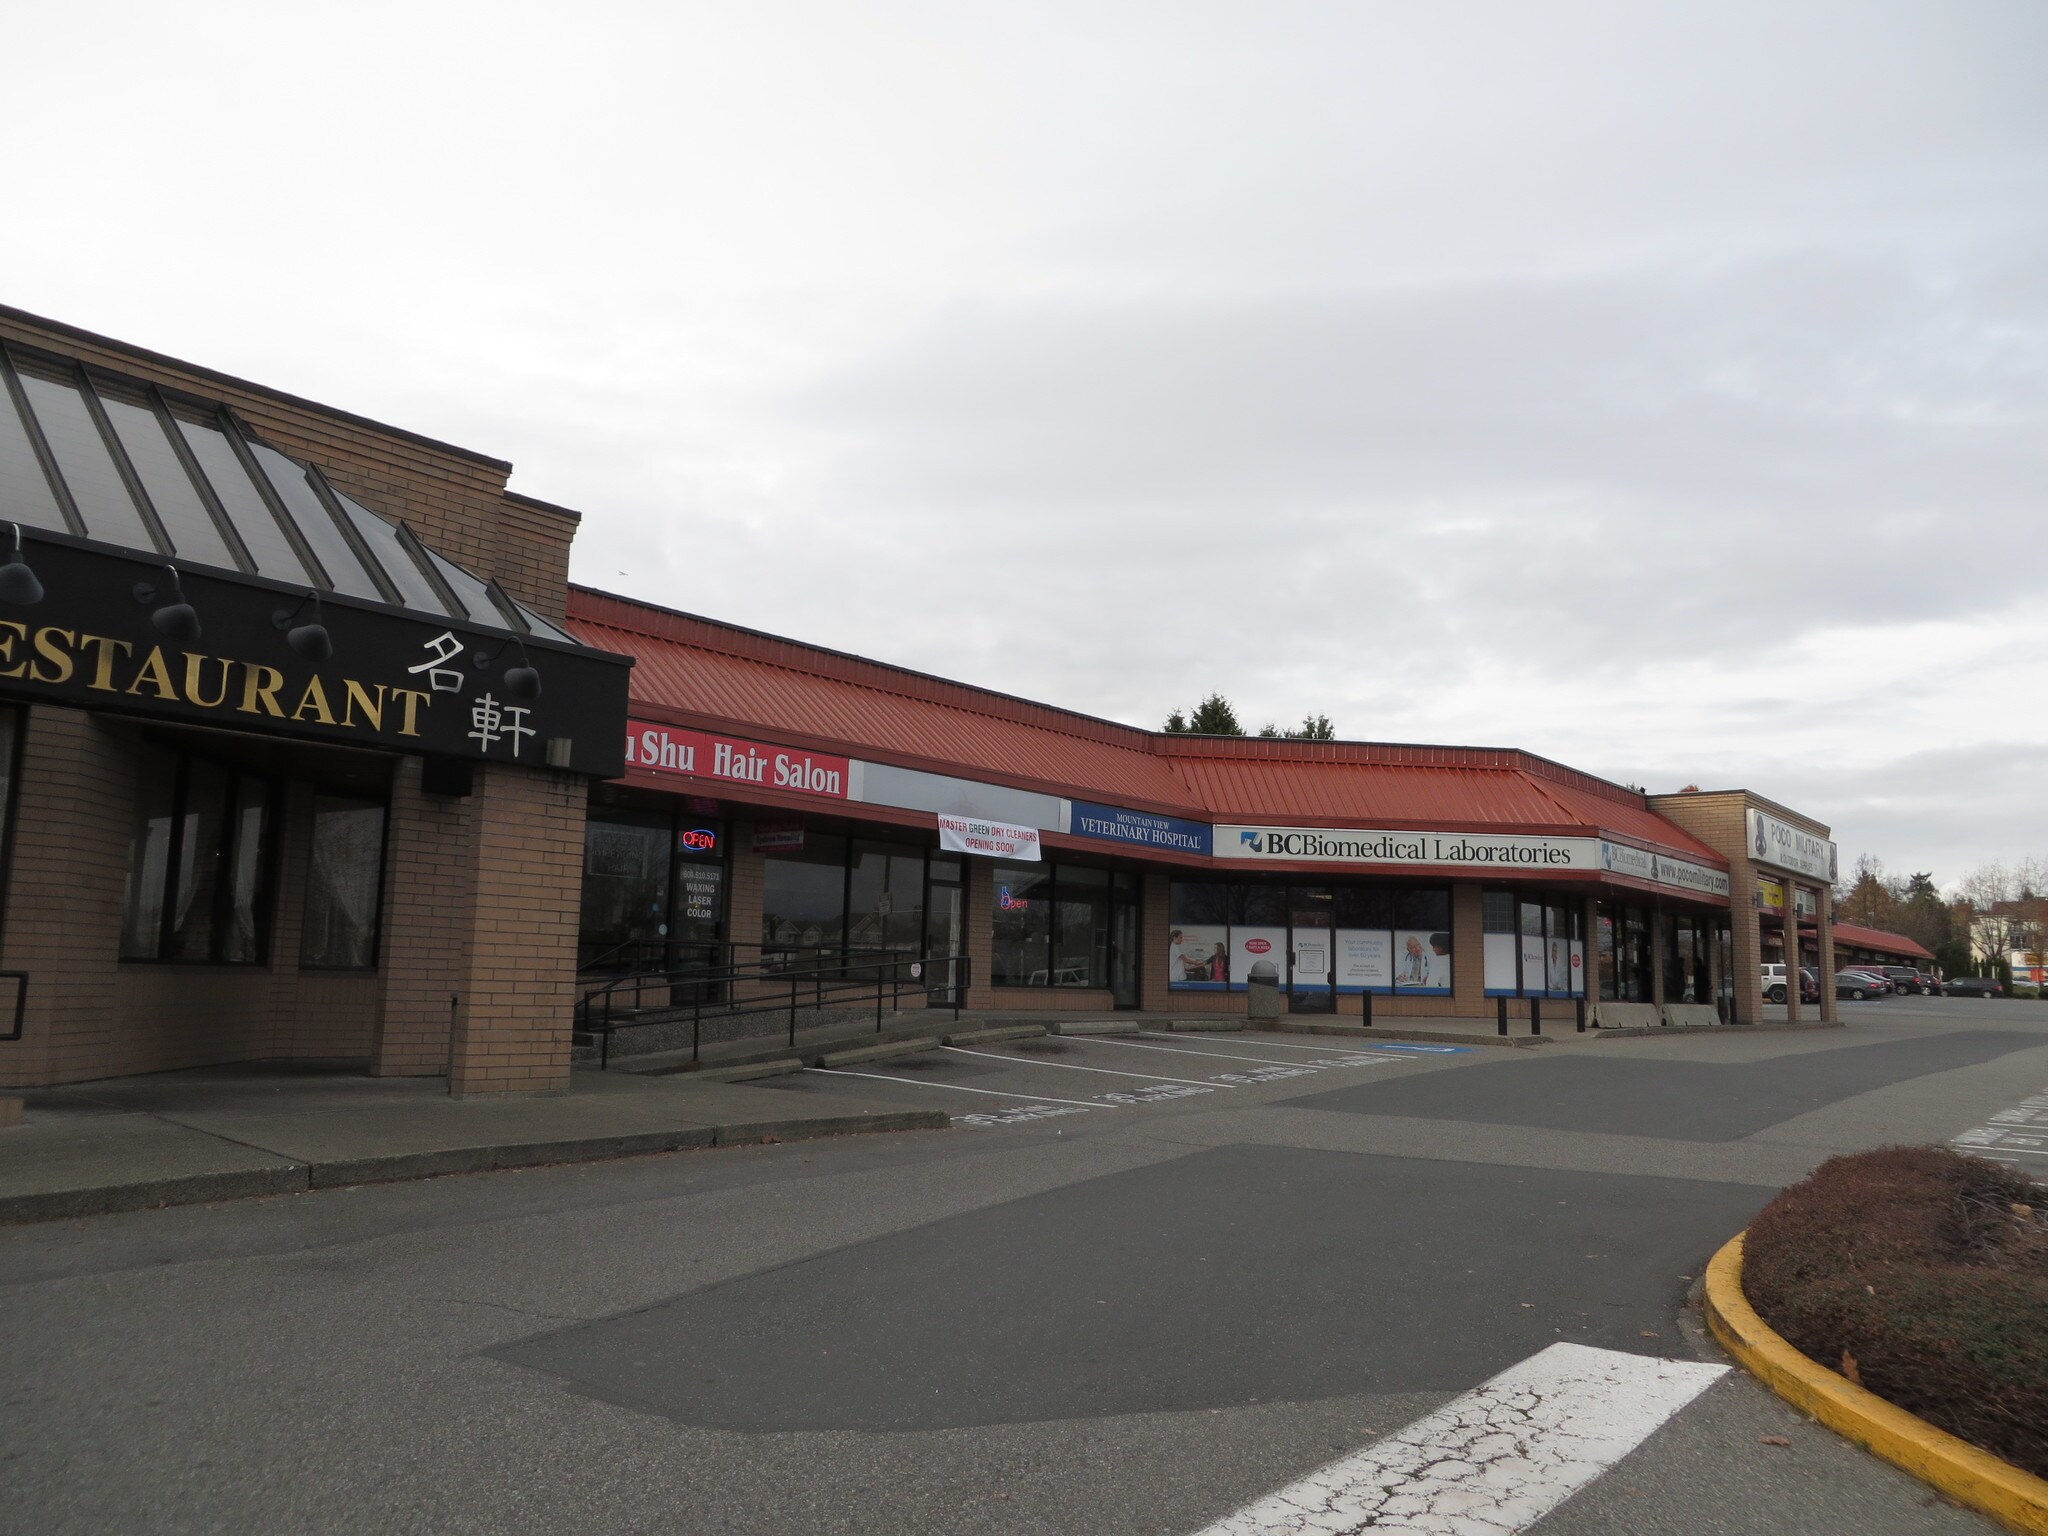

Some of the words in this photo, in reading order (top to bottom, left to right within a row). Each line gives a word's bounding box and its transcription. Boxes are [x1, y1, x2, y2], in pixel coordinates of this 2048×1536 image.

[408, 631, 537, 758] 名軒
[641, 730, 694, 771] Shu
[713, 742, 767, 782] Hair
[774, 754, 840, 794] Salon
[940, 818, 968, 832] MASTER
[969, 823, 990, 835] GREEN
[991, 827, 1005, 837] DRY
[1006, 829, 1037, 842] CLEANERS
[1080, 817, 1150, 841] VETERINARY
[1152, 829, 1201, 849] HOSPITAL
[1116, 813, 1152, 827] MOUNTAIN
[1153, 820, 1170, 830] VIEW
[682, 831, 714, 849] OPEN
[965, 838, 994, 851] OPENING
[995, 841, 1015, 853] SOON
[1266, 832, 1427, 860] BCBiomedical
[1434, 839, 1571, 864] Laboratories
[1771, 823, 1792, 848] POCO
[1795, 833, 1824, 860] MILITARY
[686, 882, 715, 893] WAXING
[1660, 863, 1728, 891] www.pocomilitary.com
[688, 895, 712, 906] LASER
[687, 908, 712, 919] COLOR
